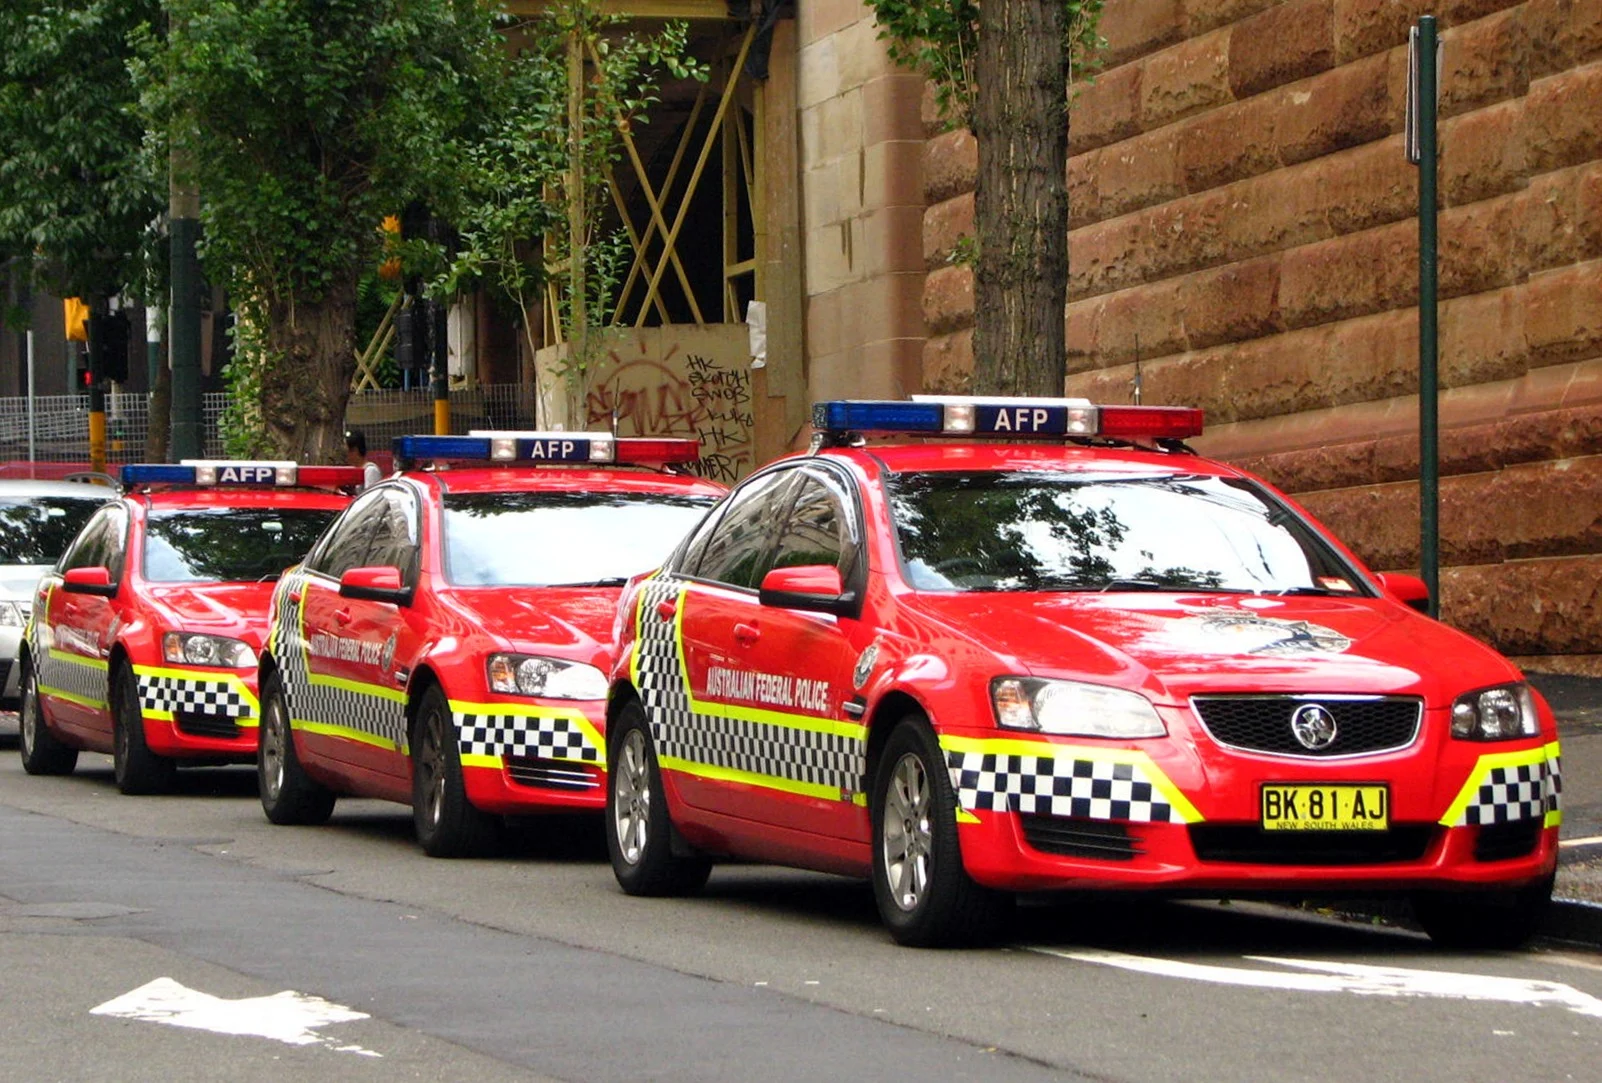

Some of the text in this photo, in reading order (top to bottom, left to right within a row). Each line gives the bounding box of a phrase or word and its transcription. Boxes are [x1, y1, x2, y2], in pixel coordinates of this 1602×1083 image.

[994, 408, 1049, 432] AFP
[531, 441, 575, 459] AFP
[220, 467, 273, 483] AFP
[706, 667, 829, 711] AUSTRALIAN FEDERAL POLICE
[1276, 821, 1374, 830] NEW SOUTH WALES
